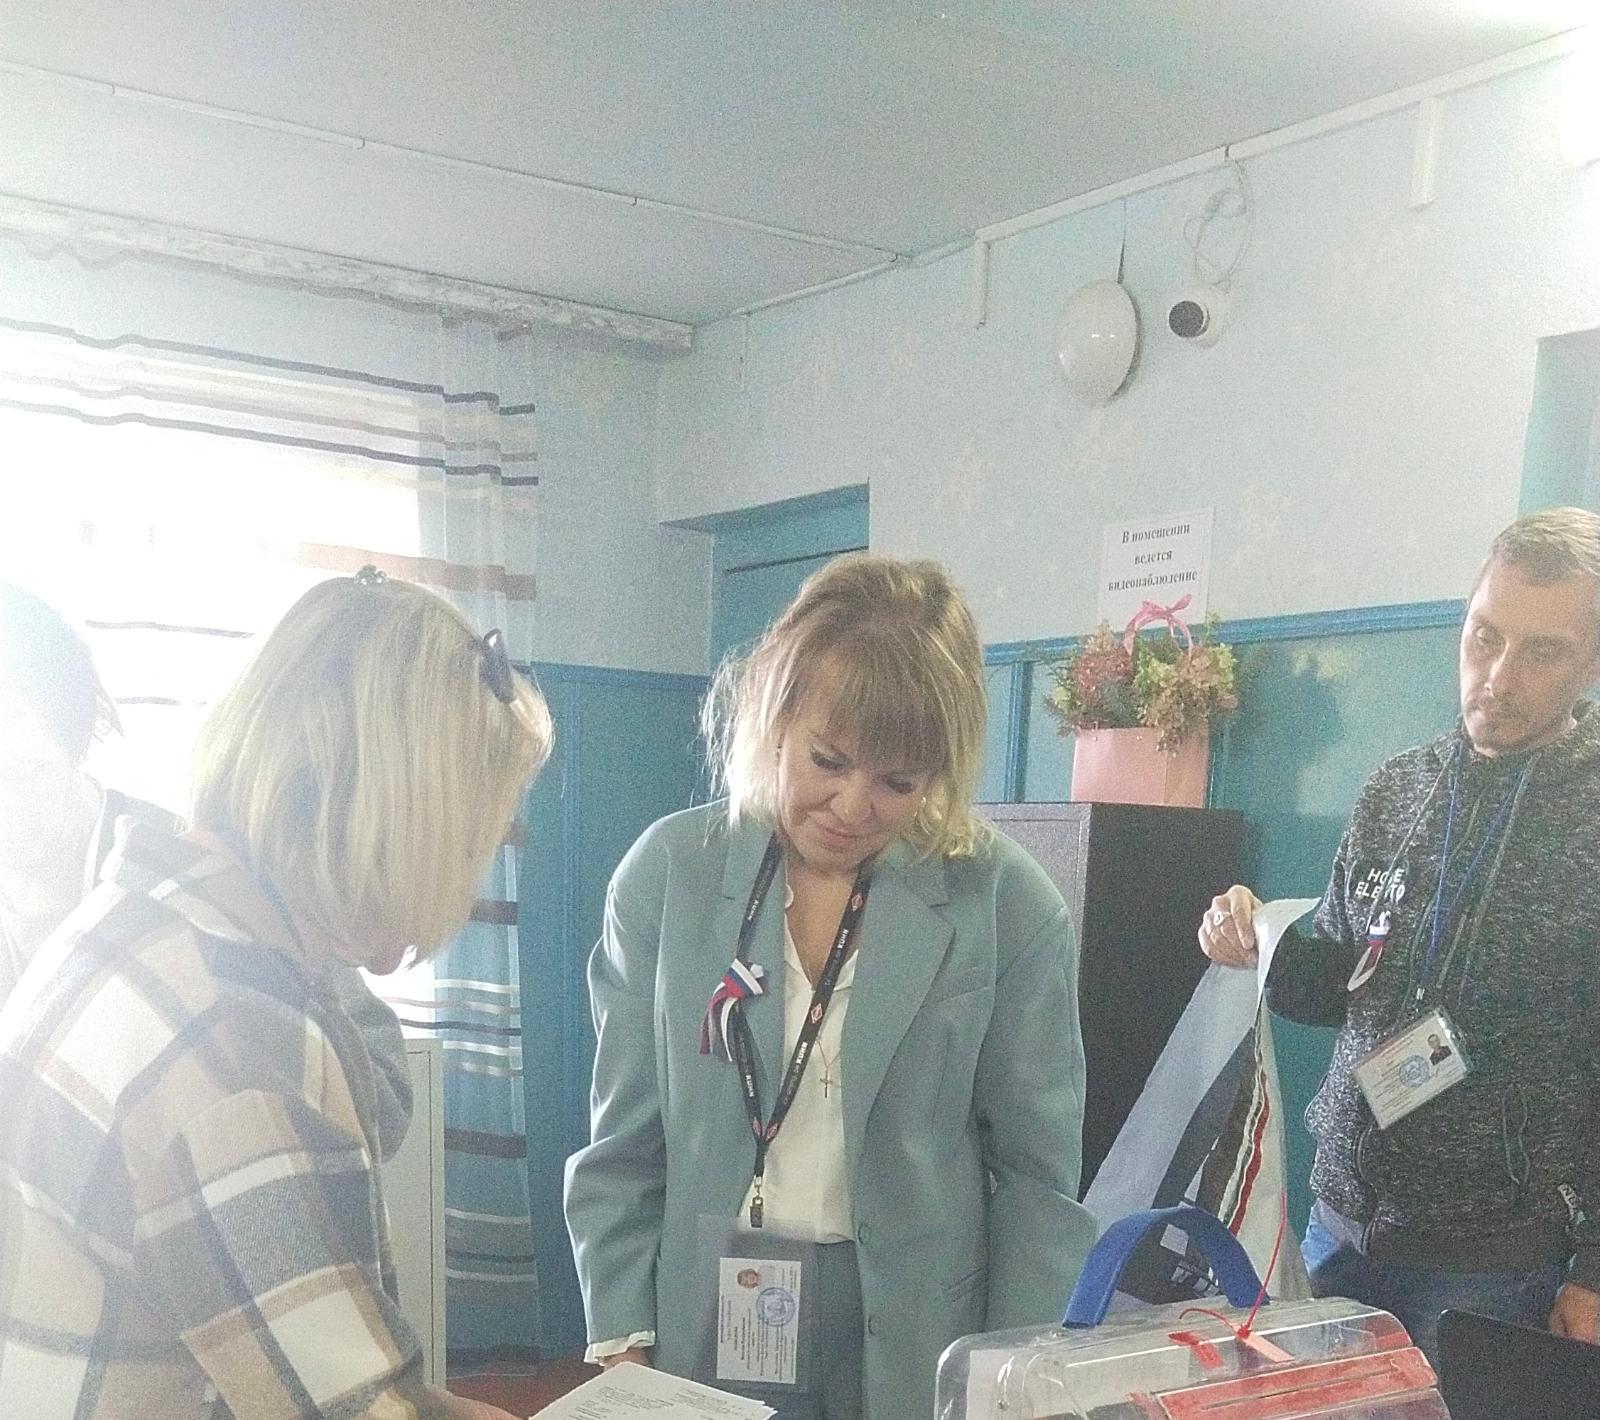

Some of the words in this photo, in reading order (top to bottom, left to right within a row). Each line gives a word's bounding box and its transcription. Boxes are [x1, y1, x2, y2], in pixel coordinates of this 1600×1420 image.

[1122, 531, 1129, 544] В
[1132, 523, 1190, 541] помещении
[1134, 550, 1172, 565] ведется
[1108, 571, 1198, 591] видеонаблюдение
[837, 929, 848, 948] KUHN
[796, 1042, 808, 1064] KUHN
